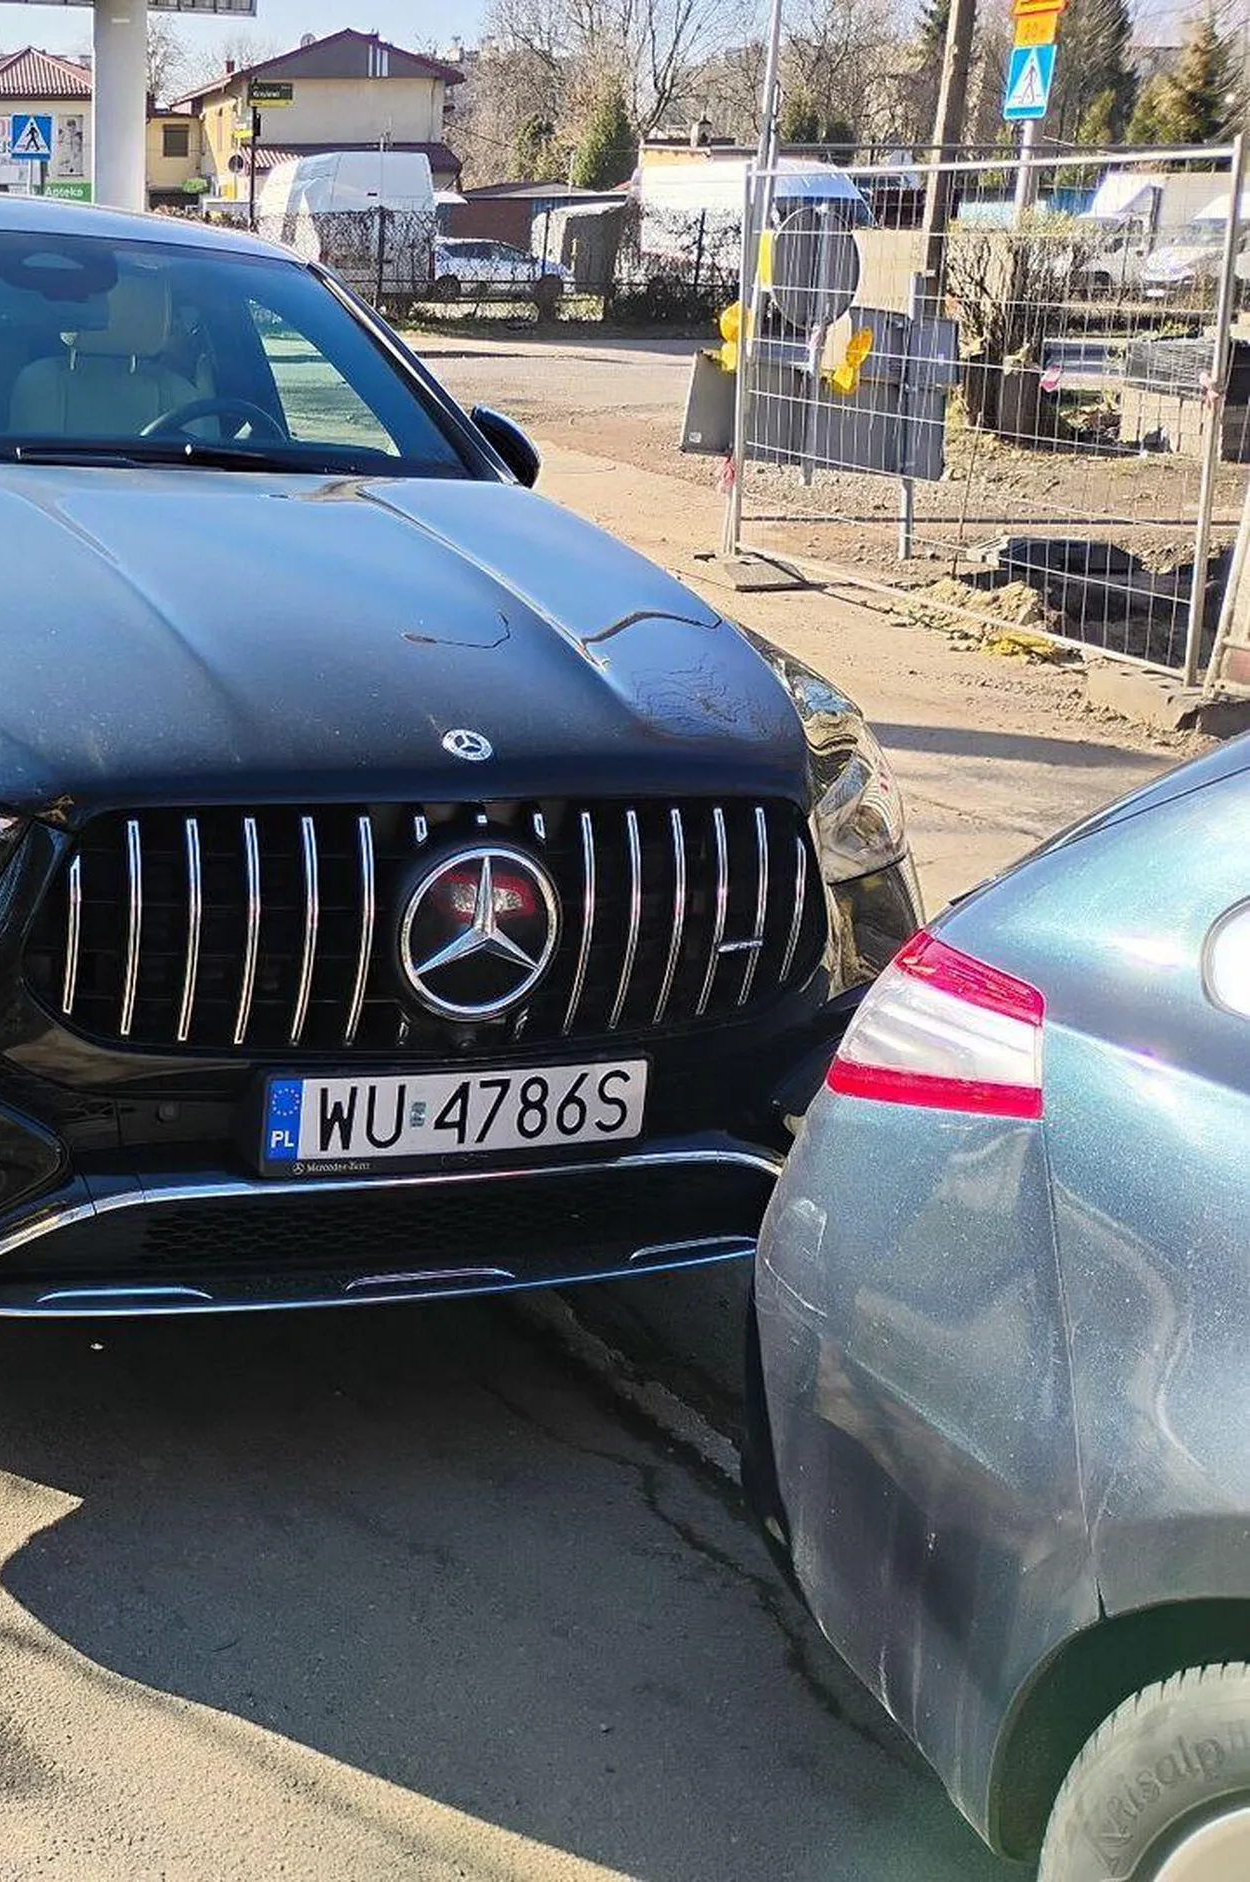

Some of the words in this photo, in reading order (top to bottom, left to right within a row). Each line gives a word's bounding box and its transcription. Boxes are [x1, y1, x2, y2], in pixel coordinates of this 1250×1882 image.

[319, 1084, 406, 1151] WU
[433, 1069, 631, 1145] 4786S
[270, 1131, 294, 1148] PL
